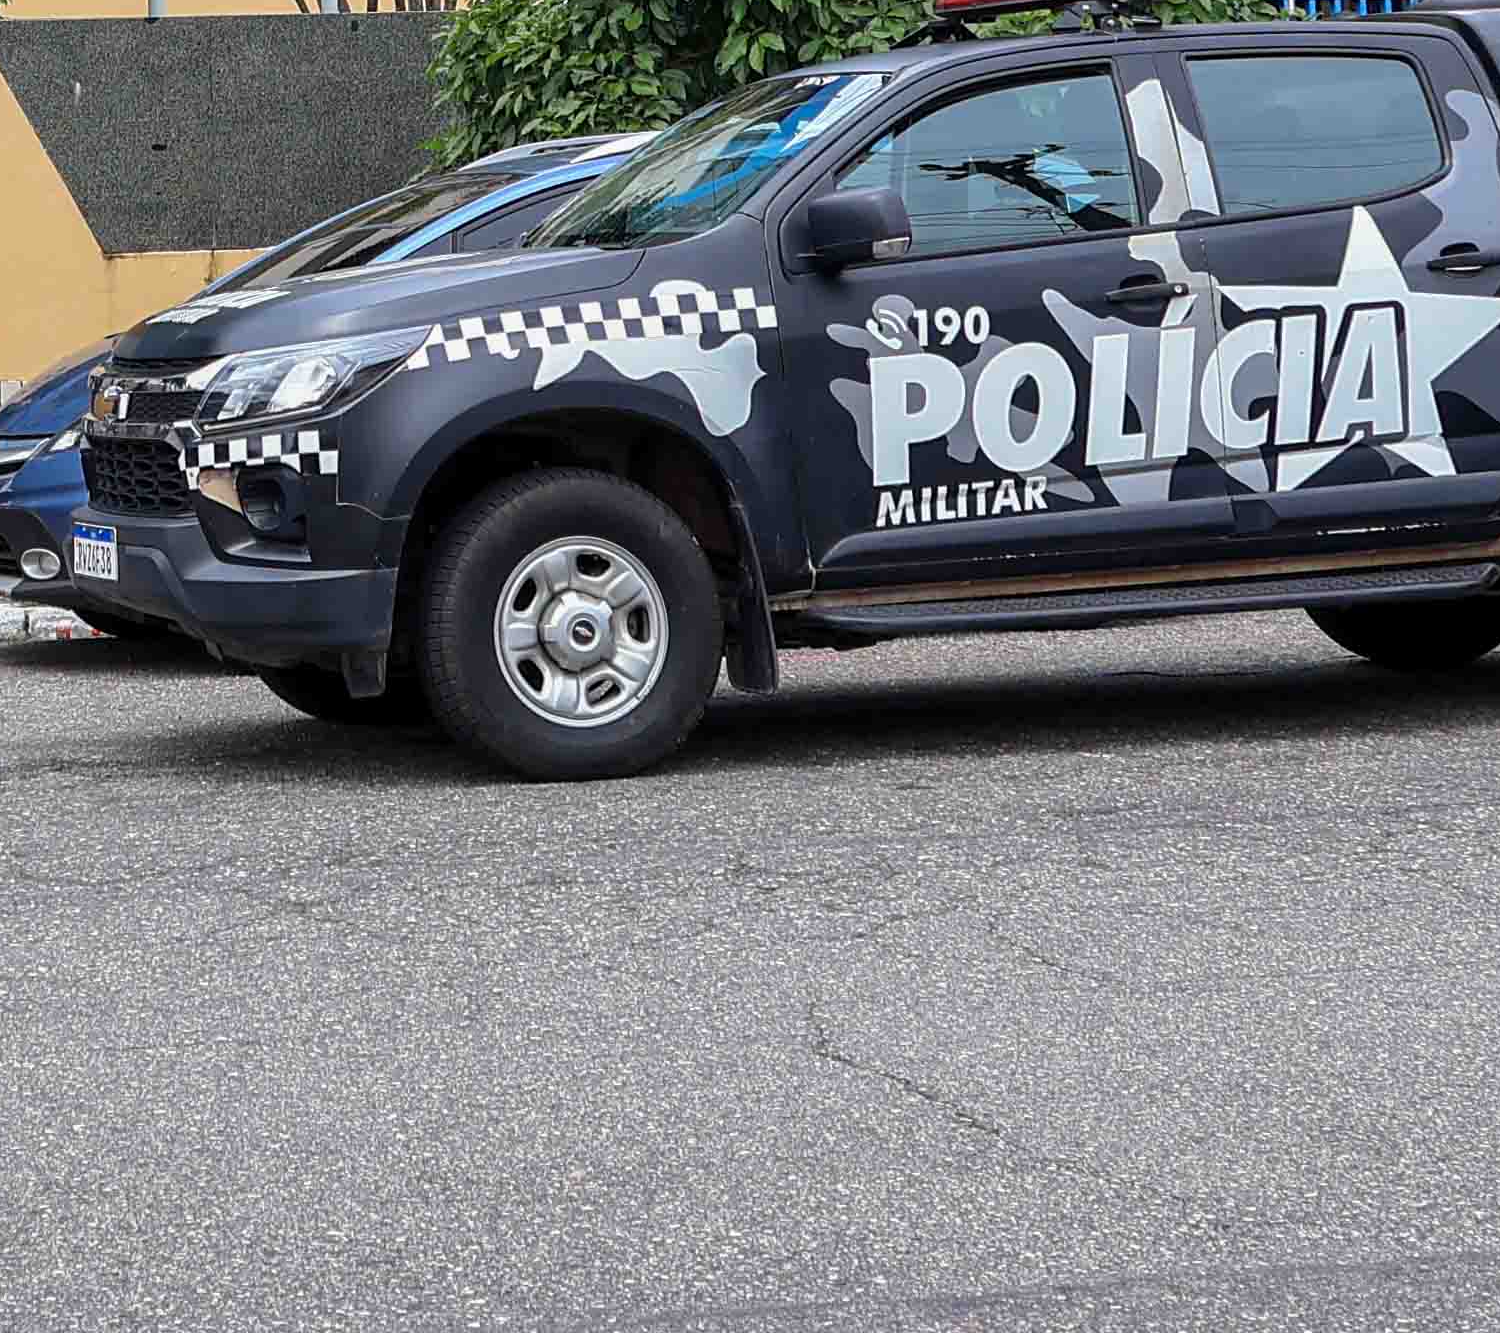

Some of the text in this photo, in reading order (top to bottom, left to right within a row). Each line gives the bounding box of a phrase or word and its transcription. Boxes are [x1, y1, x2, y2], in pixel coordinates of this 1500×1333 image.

[912, 306, 990, 346] 190
[869, 294, 1403, 487] POLÍCIA
[875, 476, 1048, 528] MILITAR
